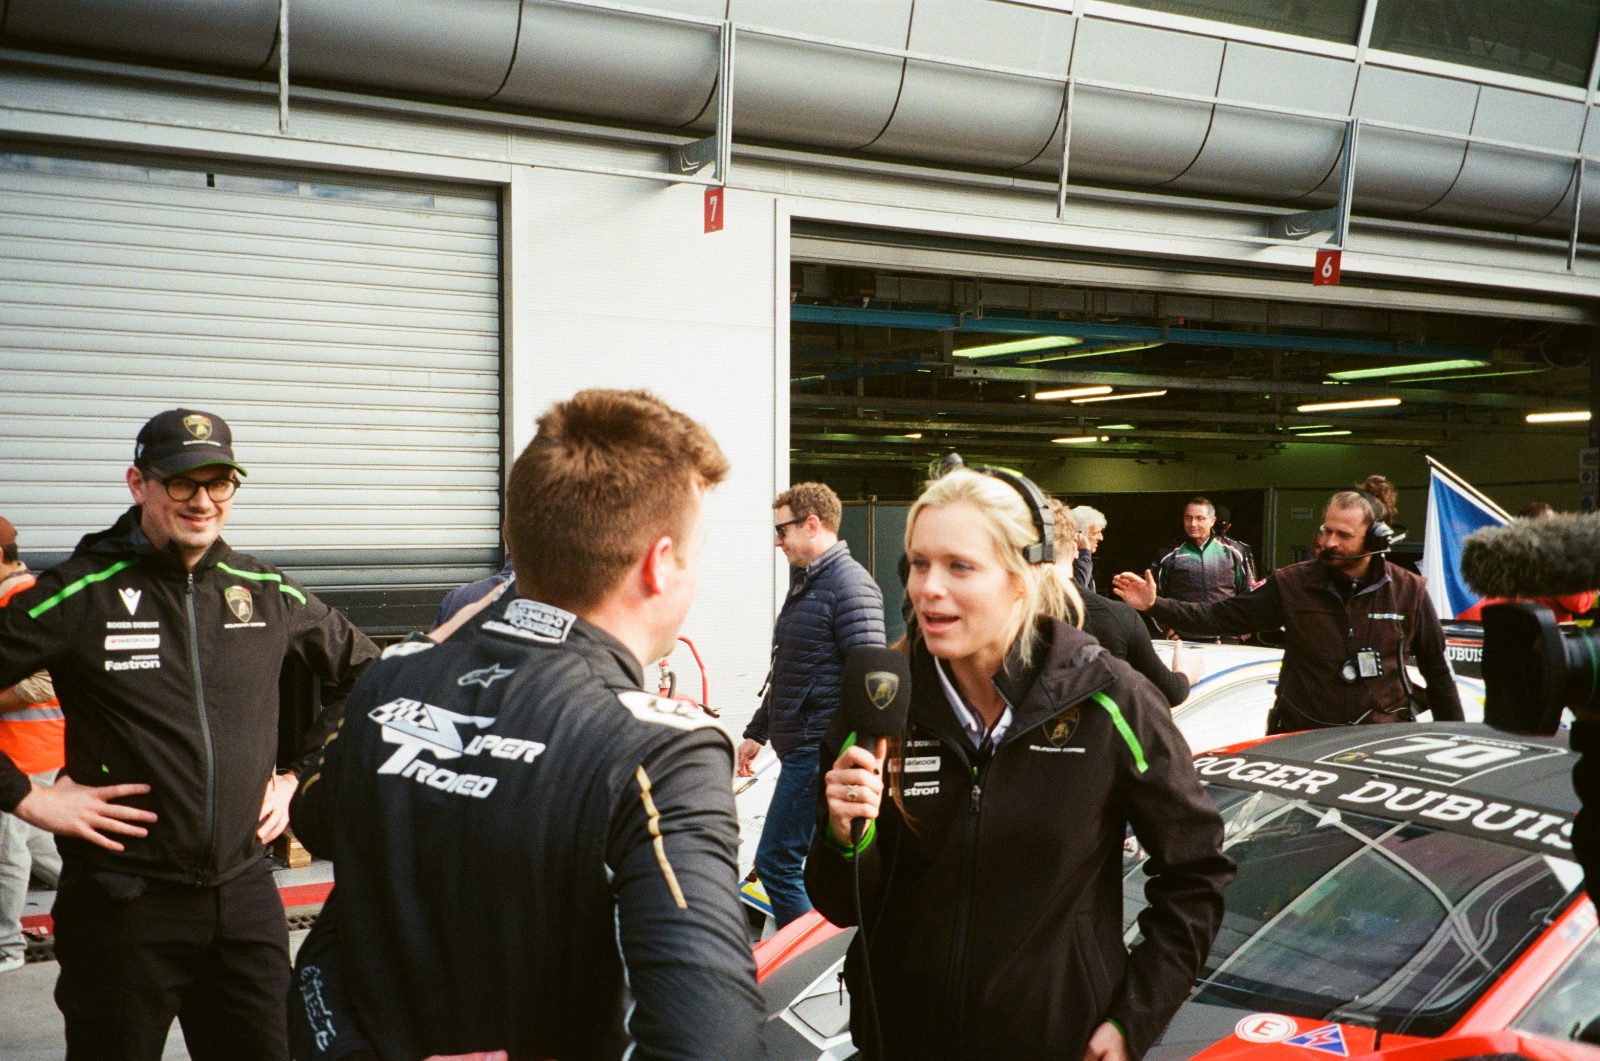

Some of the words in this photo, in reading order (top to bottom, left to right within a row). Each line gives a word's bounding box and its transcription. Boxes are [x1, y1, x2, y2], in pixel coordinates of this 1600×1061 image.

[709, 195, 718, 222] 7
[1321, 256, 1333, 278] 6
[1445, 646, 1483, 662] UBUIS
[105, 660, 160, 671] Fastron
[1374, 737, 1521, 768] 70
[1338, 781, 1573, 849] DUBUIS
[1252, 1020, 1281, 1037] E
